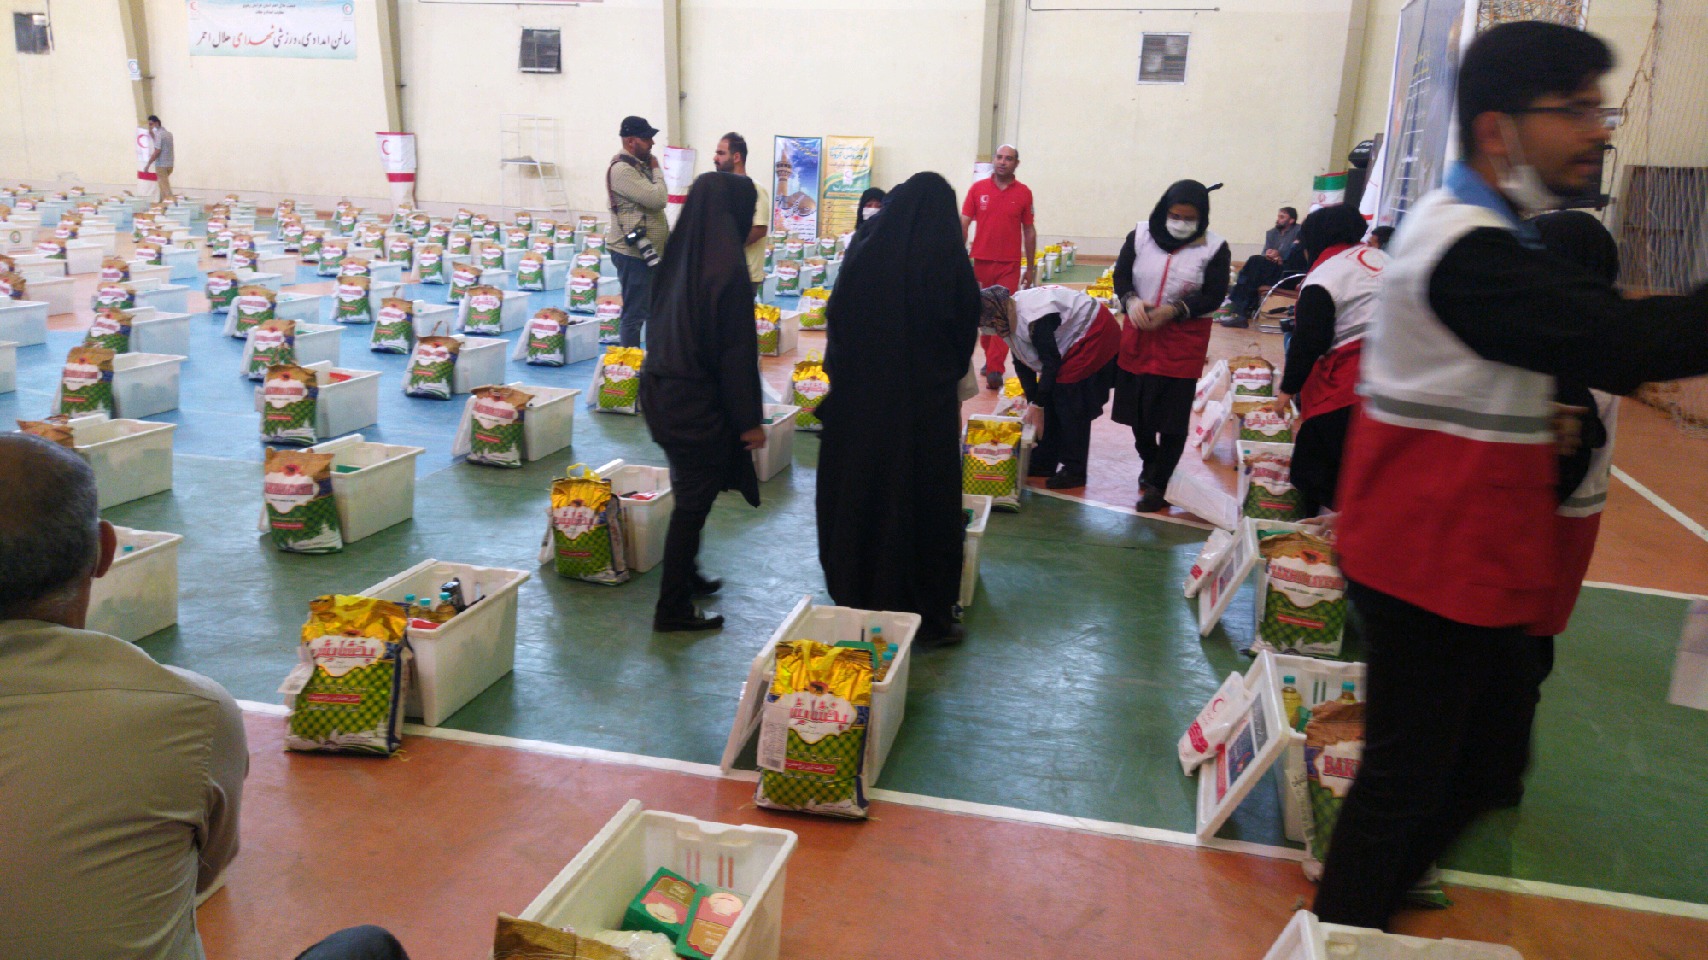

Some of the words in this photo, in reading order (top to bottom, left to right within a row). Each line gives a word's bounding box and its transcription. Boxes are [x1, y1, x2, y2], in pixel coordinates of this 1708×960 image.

[196, 31, 211, 47] احمر
[212, 31, 231, 49] هلال
[232, 24, 275, 49] شهدای
[273, 27, 298, 49] ورزشی
[330, 30, 351, 50] سالن
[311, 638, 377, 665] بخشایش
